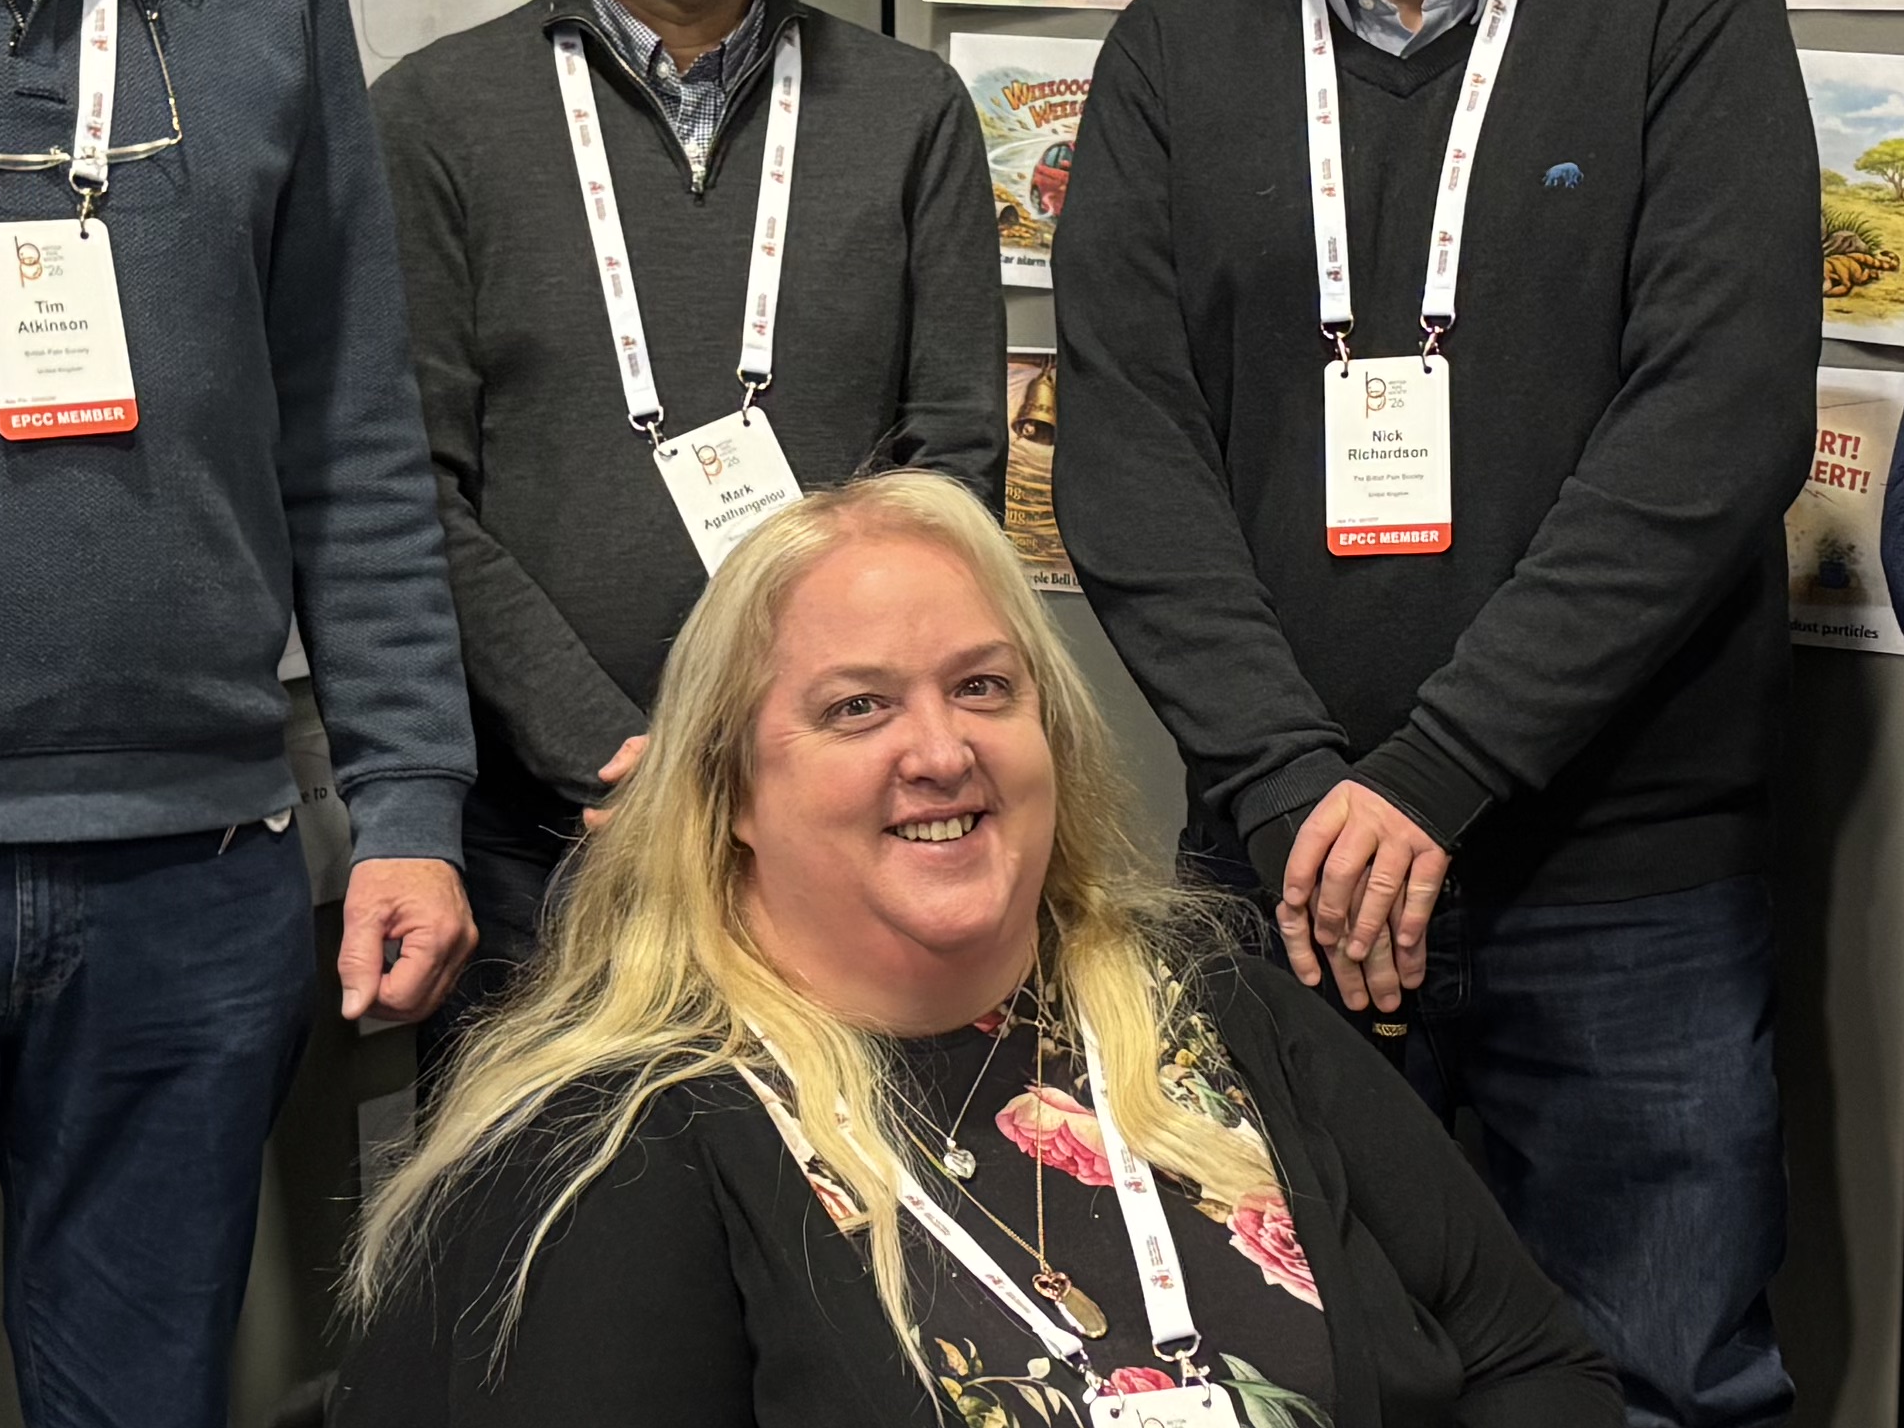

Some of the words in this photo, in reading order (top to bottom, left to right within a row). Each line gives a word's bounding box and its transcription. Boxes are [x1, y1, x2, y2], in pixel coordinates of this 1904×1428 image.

[35, 301, 64, 313] Tim
[18, 320, 88, 334] Atkinson
[11, 413, 53, 428] EPCC
[57, 407, 125, 424] MEMBER
[1373, 430, 1402, 442] Nick
[1349, 448, 1428, 460] Richardson
[721, 485, 753, 503] Mark
[1340, 533, 1375, 545] EPCC
[1380, 531, 1438, 543] MEMBER
